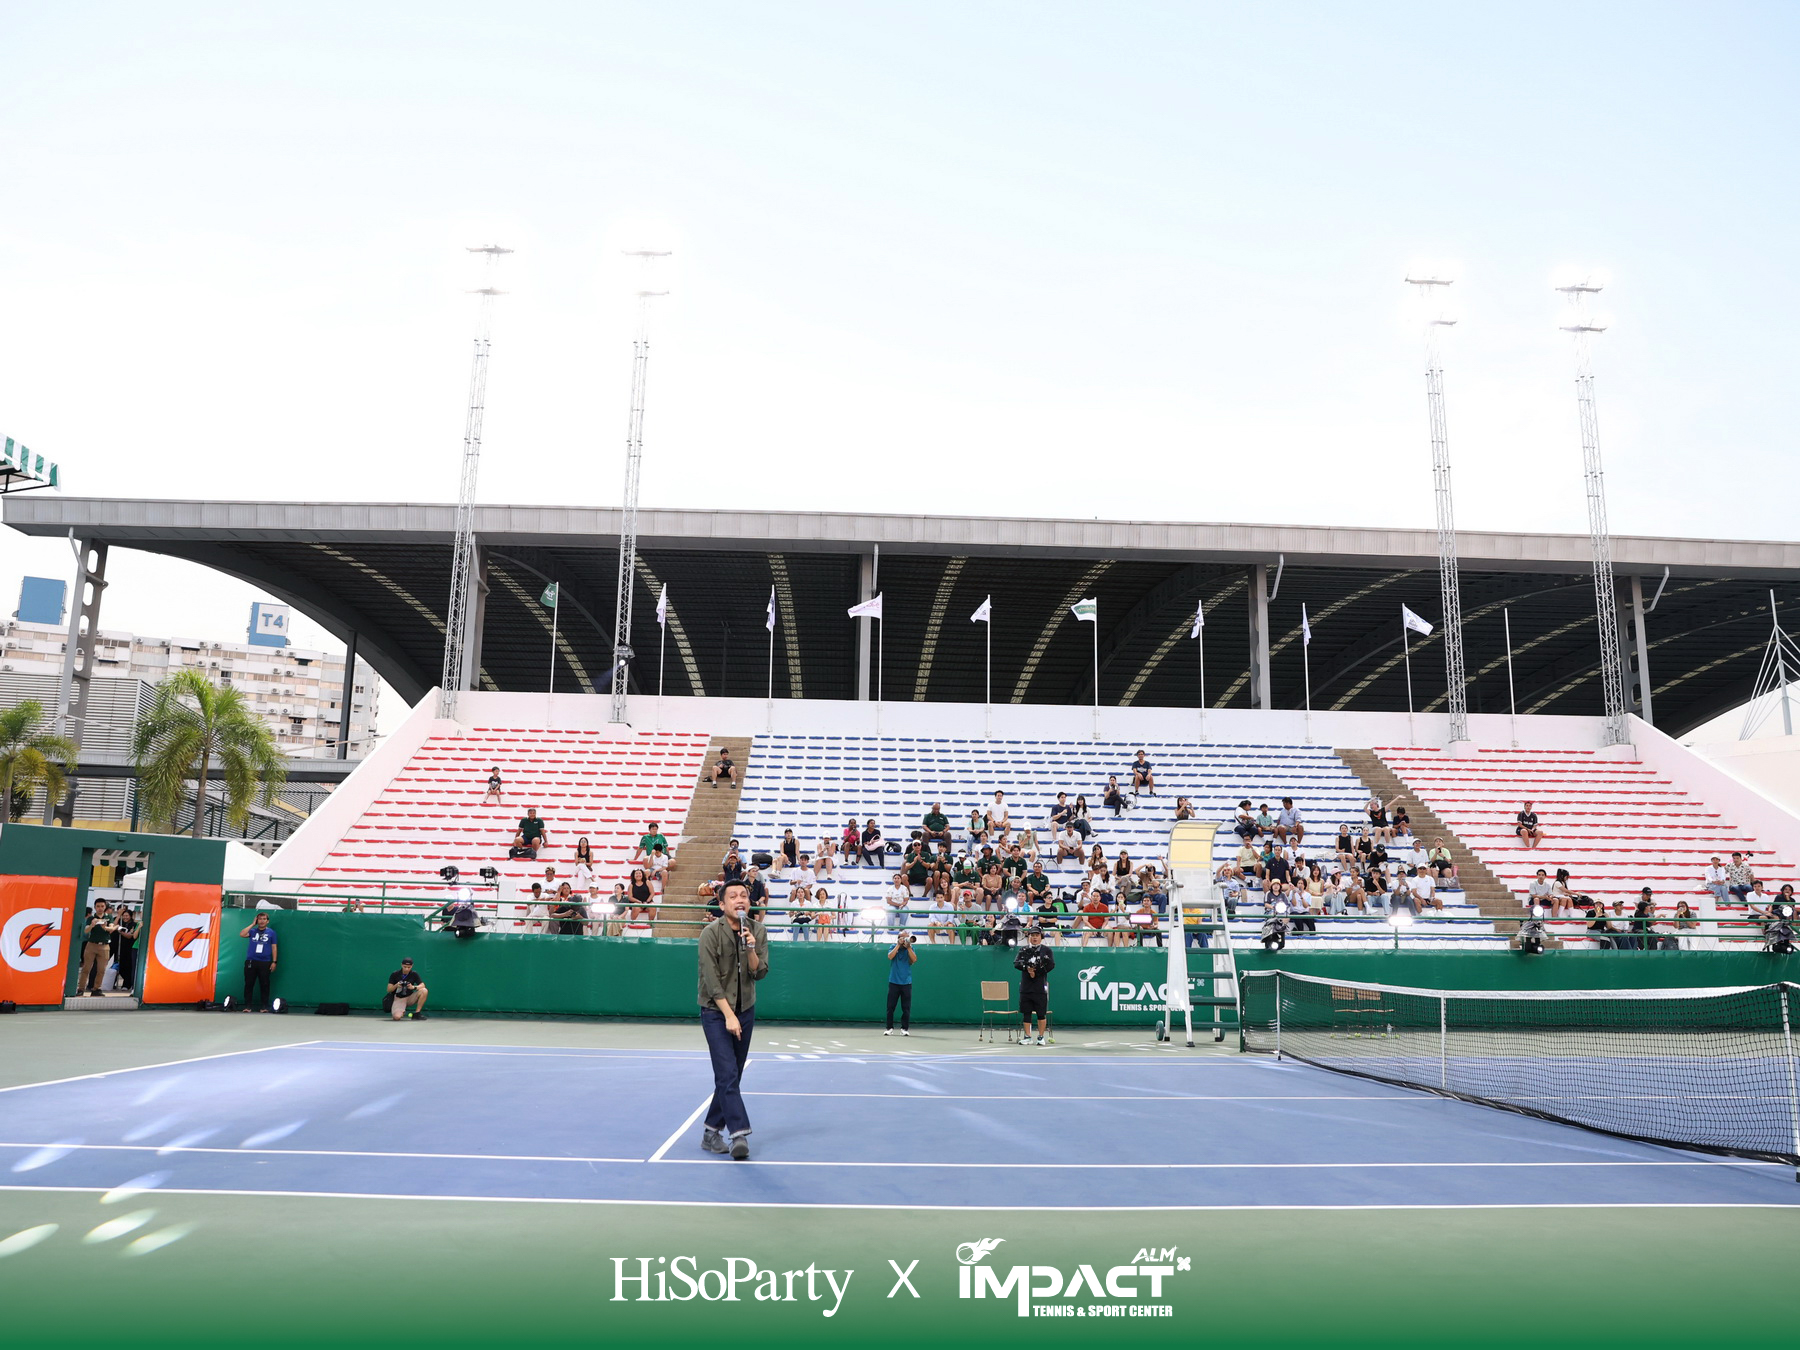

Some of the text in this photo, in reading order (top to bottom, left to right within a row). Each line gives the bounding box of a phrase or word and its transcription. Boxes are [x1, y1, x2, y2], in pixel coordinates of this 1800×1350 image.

[262, 613, 284, 628] T4
[0, 908, 63, 972] G
[155, 913, 211, 973] G
[1119, 1003, 1141, 1011] TENNIS
